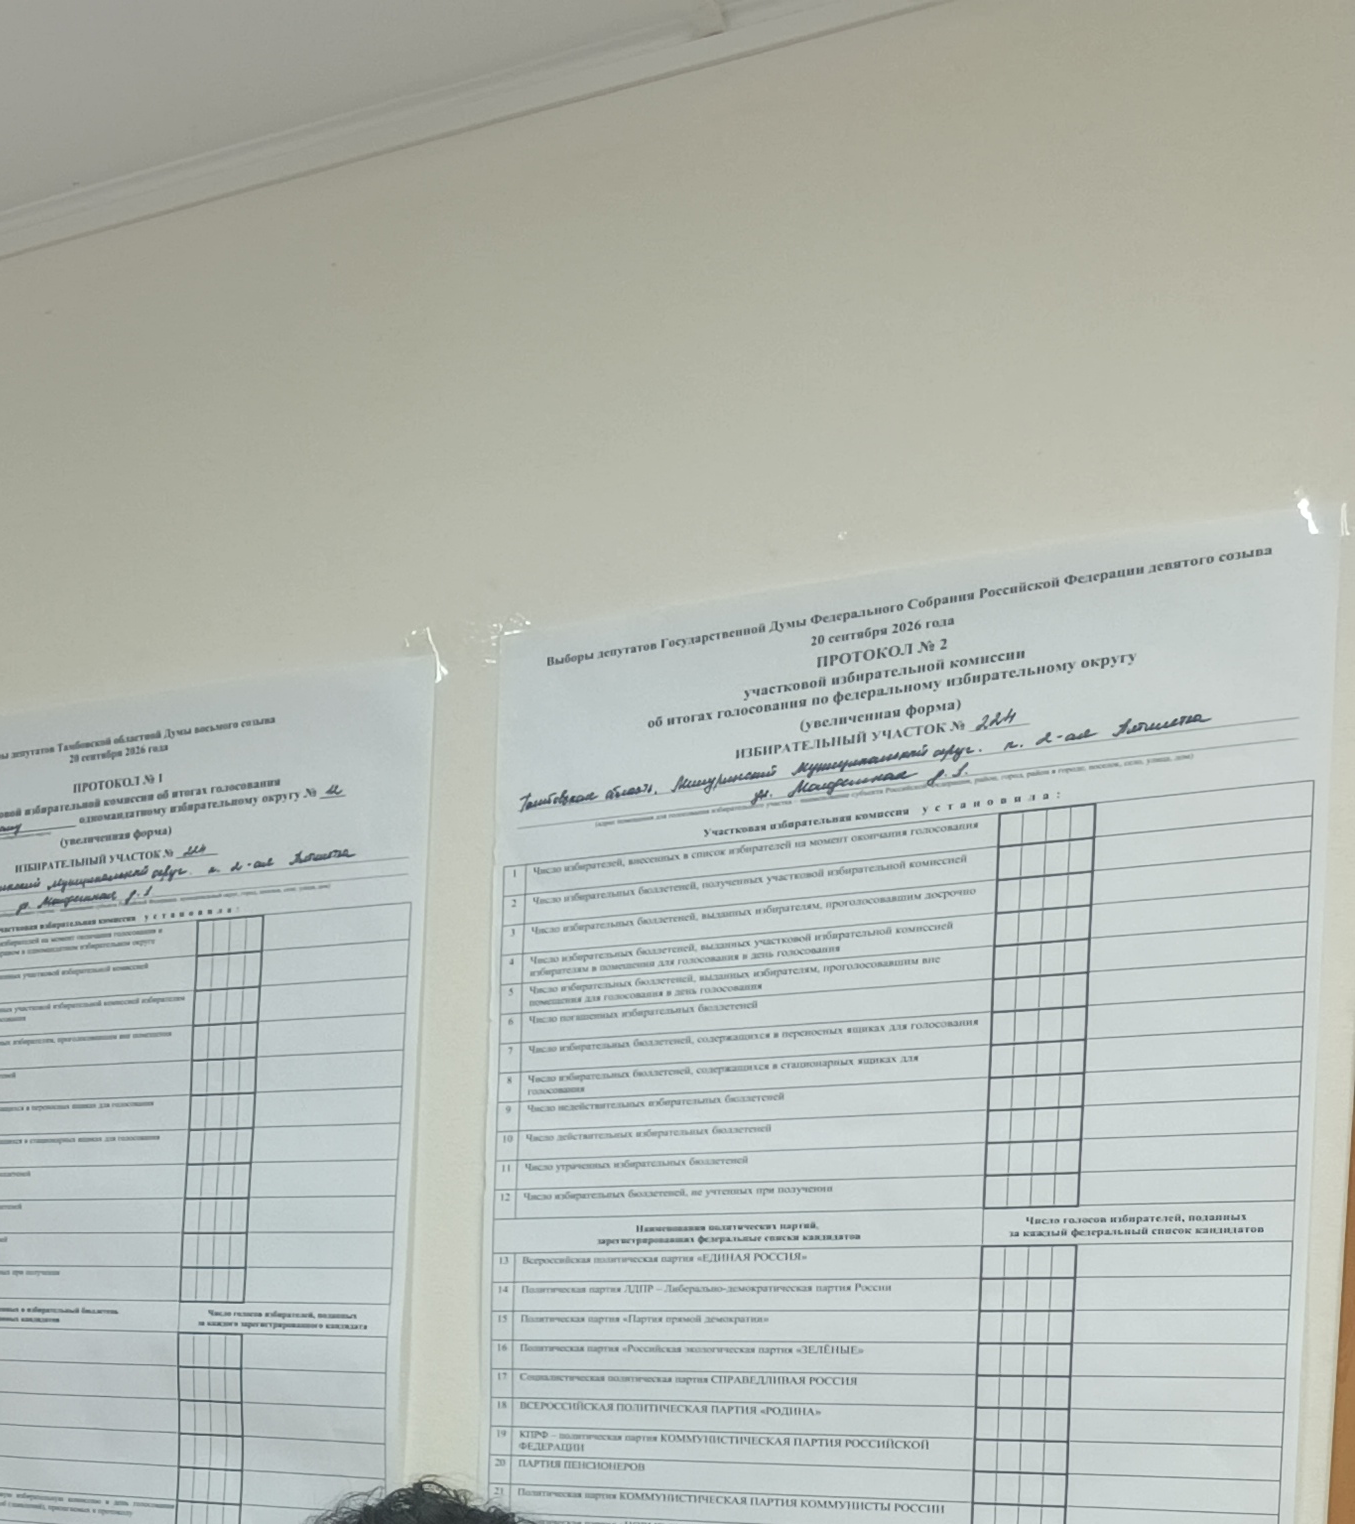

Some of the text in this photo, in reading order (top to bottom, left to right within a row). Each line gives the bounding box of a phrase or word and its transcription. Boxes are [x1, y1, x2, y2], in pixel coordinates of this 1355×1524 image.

[546, 547, 1272, 667] Выборы депутатов Государственной Думы Федерального Собрания Российской Федерации девятого созыва
[810, 617, 955, 647] 20 сентября 2026 года
[816, 638, 948, 669] ПРОТОКОЛ № 2
[647, 653, 1136, 728] об итогах голосования по федеральному избирательному округу
[743, 650, 1025, 701] участковой избирательной комиссии
[799, 698, 962, 733] (увеличенная форма)
[735, 730, 867, 759] ИЗБИРАТЕЛЬНЫЙ
[871, 722, 947, 742] УЧАСТОК
[949, 720, 965, 732] №
[72, 773, 163, 794] ПРОТОКОЛ № 1
[519, 1400, 821, 1416] ВСЕРОССИЙСКАЯ ПОЛИТИЧЕСКАЯ ПАРТИЯ «РОДИНА»
[518, 1458, 645, 1472] ПАРТИЯ ПЕНСИОНЕРОВ
